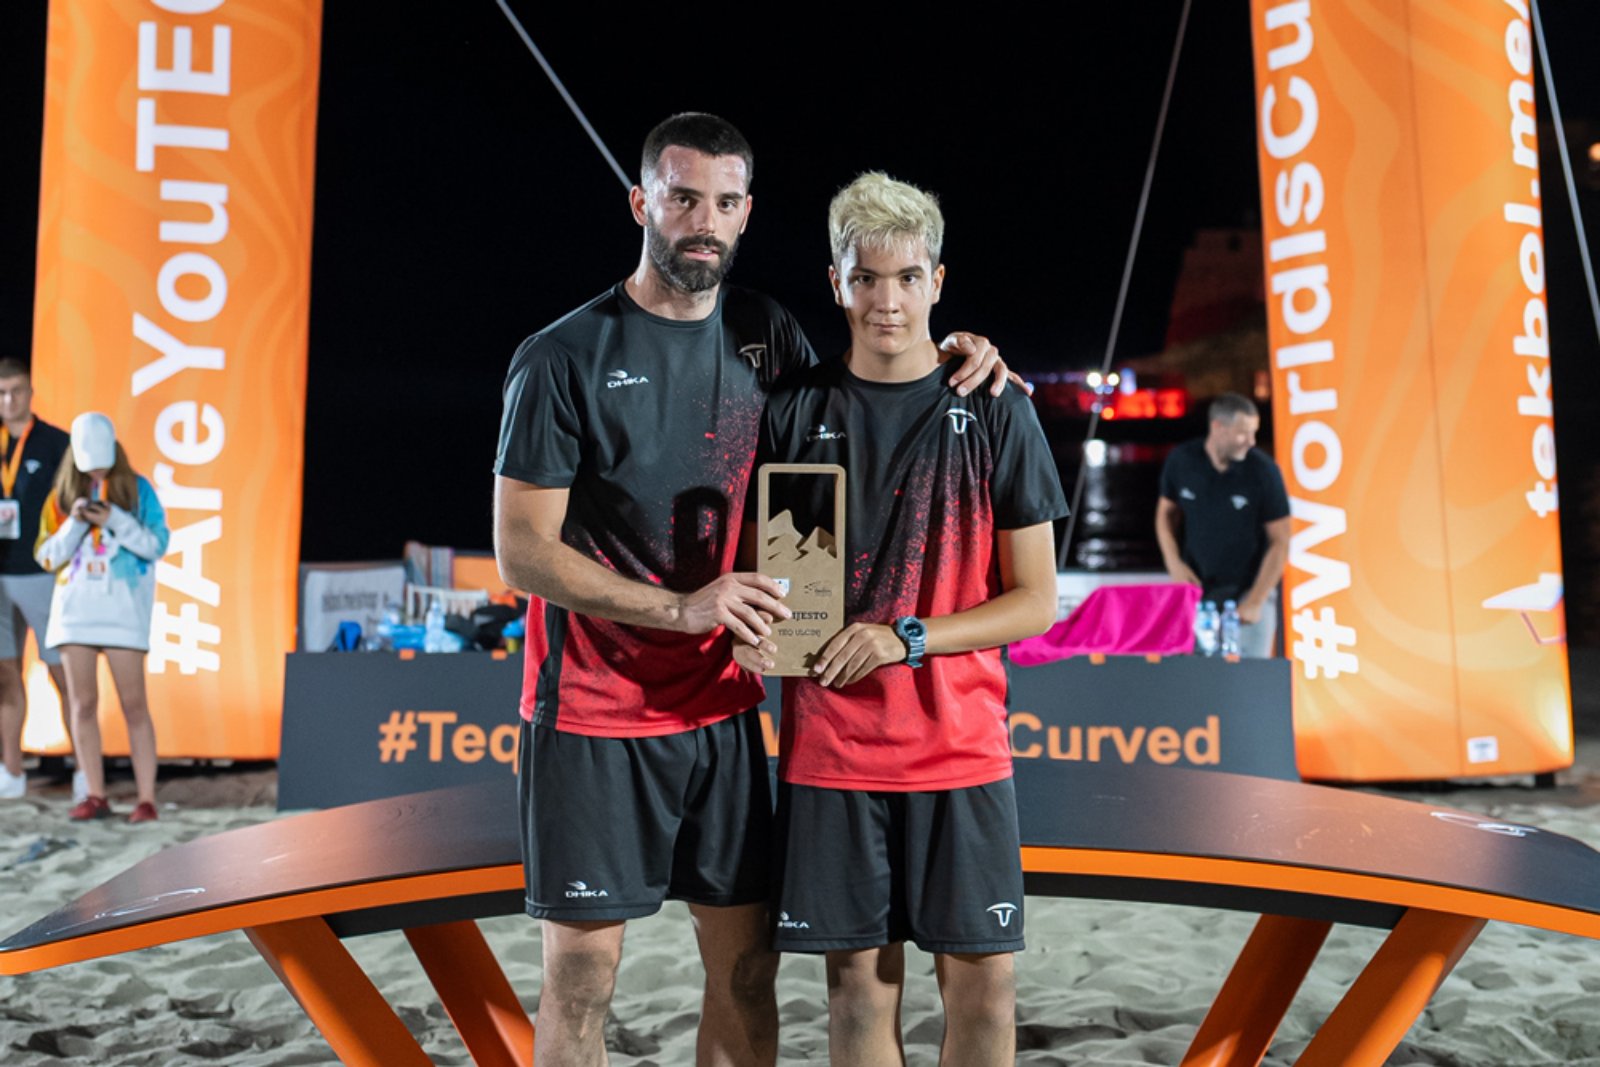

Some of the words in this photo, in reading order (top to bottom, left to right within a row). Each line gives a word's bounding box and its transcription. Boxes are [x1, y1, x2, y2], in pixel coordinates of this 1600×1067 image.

[132, 0, 231, 674] #AreYouTE
[565, 889, 608, 898] DHIKA
[777, 920, 809, 928] HIKA
